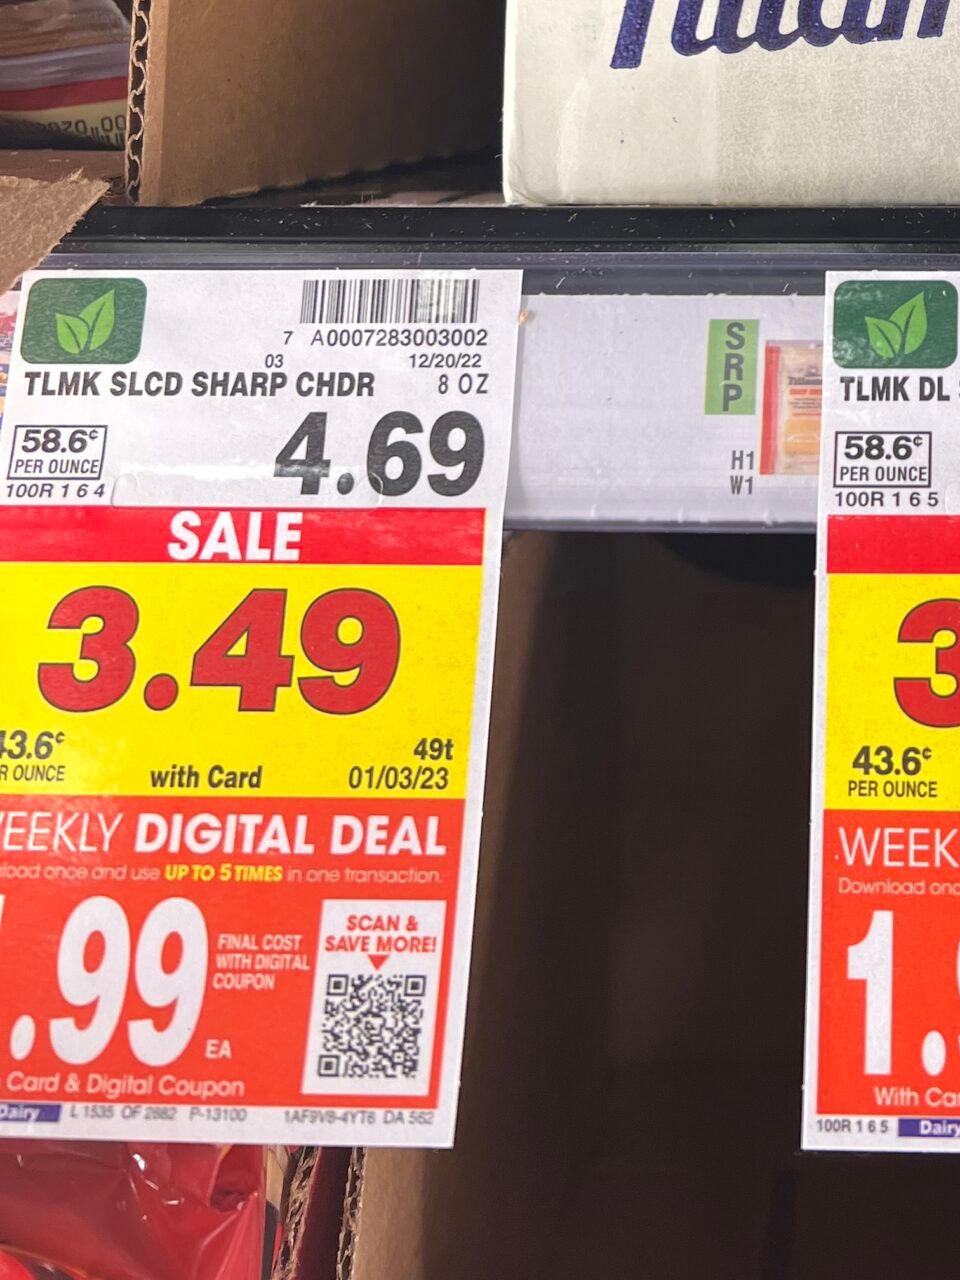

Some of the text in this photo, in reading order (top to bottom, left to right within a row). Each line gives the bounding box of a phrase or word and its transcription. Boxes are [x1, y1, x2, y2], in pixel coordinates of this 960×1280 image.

[283, 329, 489, 347] 7 A0007283003002
[264, 354, 483, 369] 03 12/20/22
[25, 371, 489, 397] TLMK SLCD SHARP CHDR 8 OZ
[840, 376, 911, 403] TLMK
[919, 376, 950, 402] DL
[273, 410, 486, 498] 4.69
[731, 450, 754, 471] H1
[14, 458, 101, 475] PER OUNCE
[840, 466, 928, 483] PER OUNCE
[5, 483, 53, 499] 100R
[730, 476, 754, 495] W1
[835, 492, 885, 508] 100R
[167, 511, 304, 561] SALE
[38, 585, 402, 716] 3.49
[414, 737, 454, 761] 49t
[13, 764, 66, 781] OUNCE
[151, 765, 449, 791] with Card 01/03/23
[848, 780, 938, 799] PER OUNCE
[0, 811, 447, 856] EEKLY DIGITAL DEAL
[44, 864, 444, 884] once and use UP TO 5 TIMES in one transaction.
[838, 877, 926, 896] Download
[346, 915, 419, 932] SCAN &
[217, 934, 302, 951] FINAL COST
[324, 935, 437, 953] SAVE MORE!
[215, 953, 310, 971] WITH DIGITAL
[213, 973, 275, 990] COUPON
[205, 1039, 231, 1059] EA
[6, 1071, 245, 1100] Card & Digital Coupon
[873, 1086, 920, 1107] With
